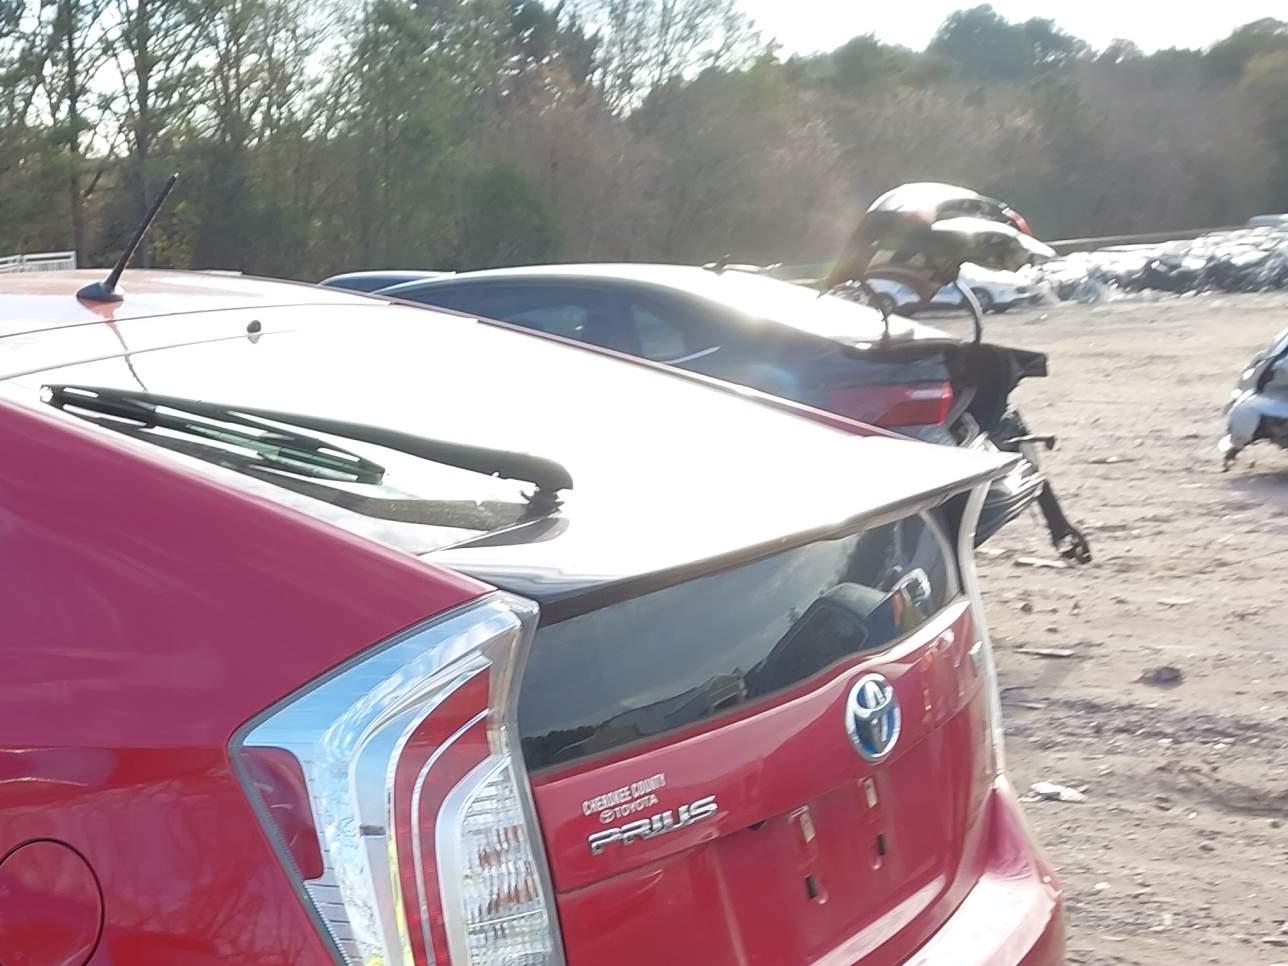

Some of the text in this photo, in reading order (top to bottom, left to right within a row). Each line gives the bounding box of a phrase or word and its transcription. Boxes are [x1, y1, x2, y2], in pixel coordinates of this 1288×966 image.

[582, 786, 632, 816] CHEROKEE
[614, 794, 659, 818] TOYOTA
[588, 795, 719, 856] PRIUS
